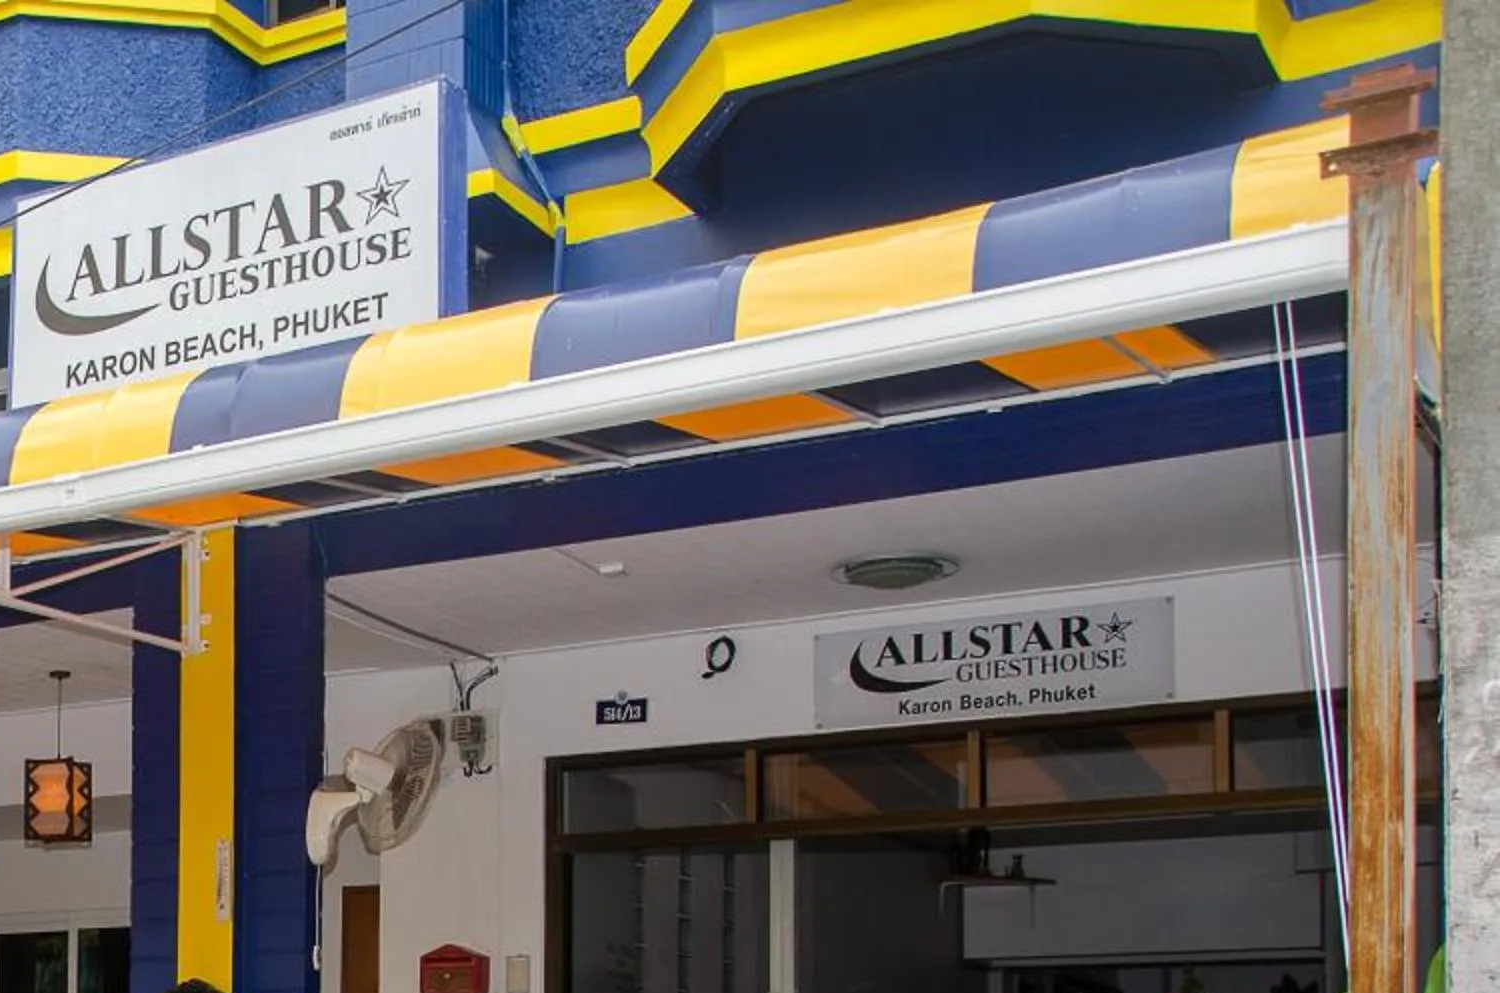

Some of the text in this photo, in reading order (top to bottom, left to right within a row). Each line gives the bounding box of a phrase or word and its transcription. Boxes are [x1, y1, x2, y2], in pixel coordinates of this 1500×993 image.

[66, 178, 353, 302] ALLSTAR
[170, 227, 412, 311] GUESTHOUSE
[65, 293, 389, 388] KARON BEACH, PHUKET
[875, 615, 1093, 668] ALLSTAR
[956, 648, 1127, 683] GUESTHOUSE
[899, 699, 952, 715] Karon
[1029, 683, 1096, 705] Phuket
